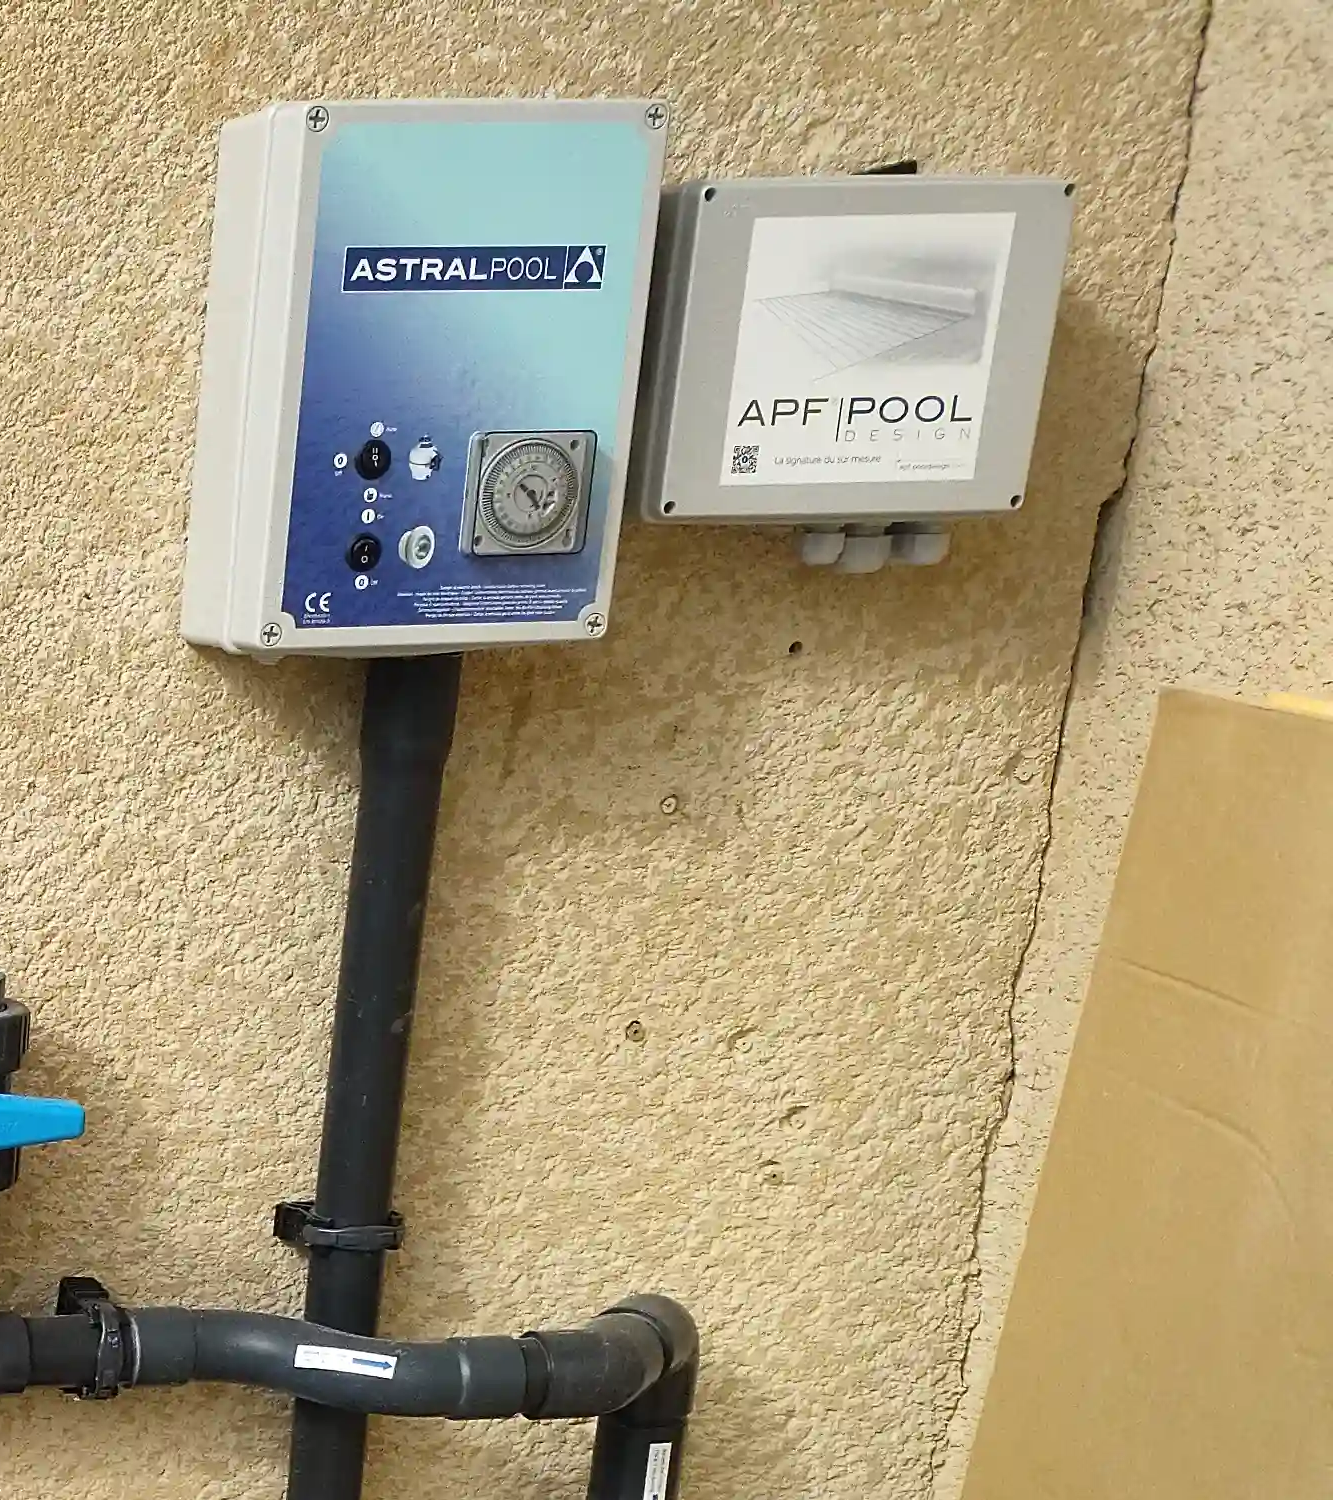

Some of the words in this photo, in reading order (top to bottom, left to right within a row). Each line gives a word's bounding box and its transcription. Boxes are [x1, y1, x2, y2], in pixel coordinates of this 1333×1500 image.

[349, 256, 558, 282] ASTRALPOOL
[736, 398, 830, 427] APF
[846, 394, 973, 425] POOL
[843, 428, 973, 443] DESIGN
